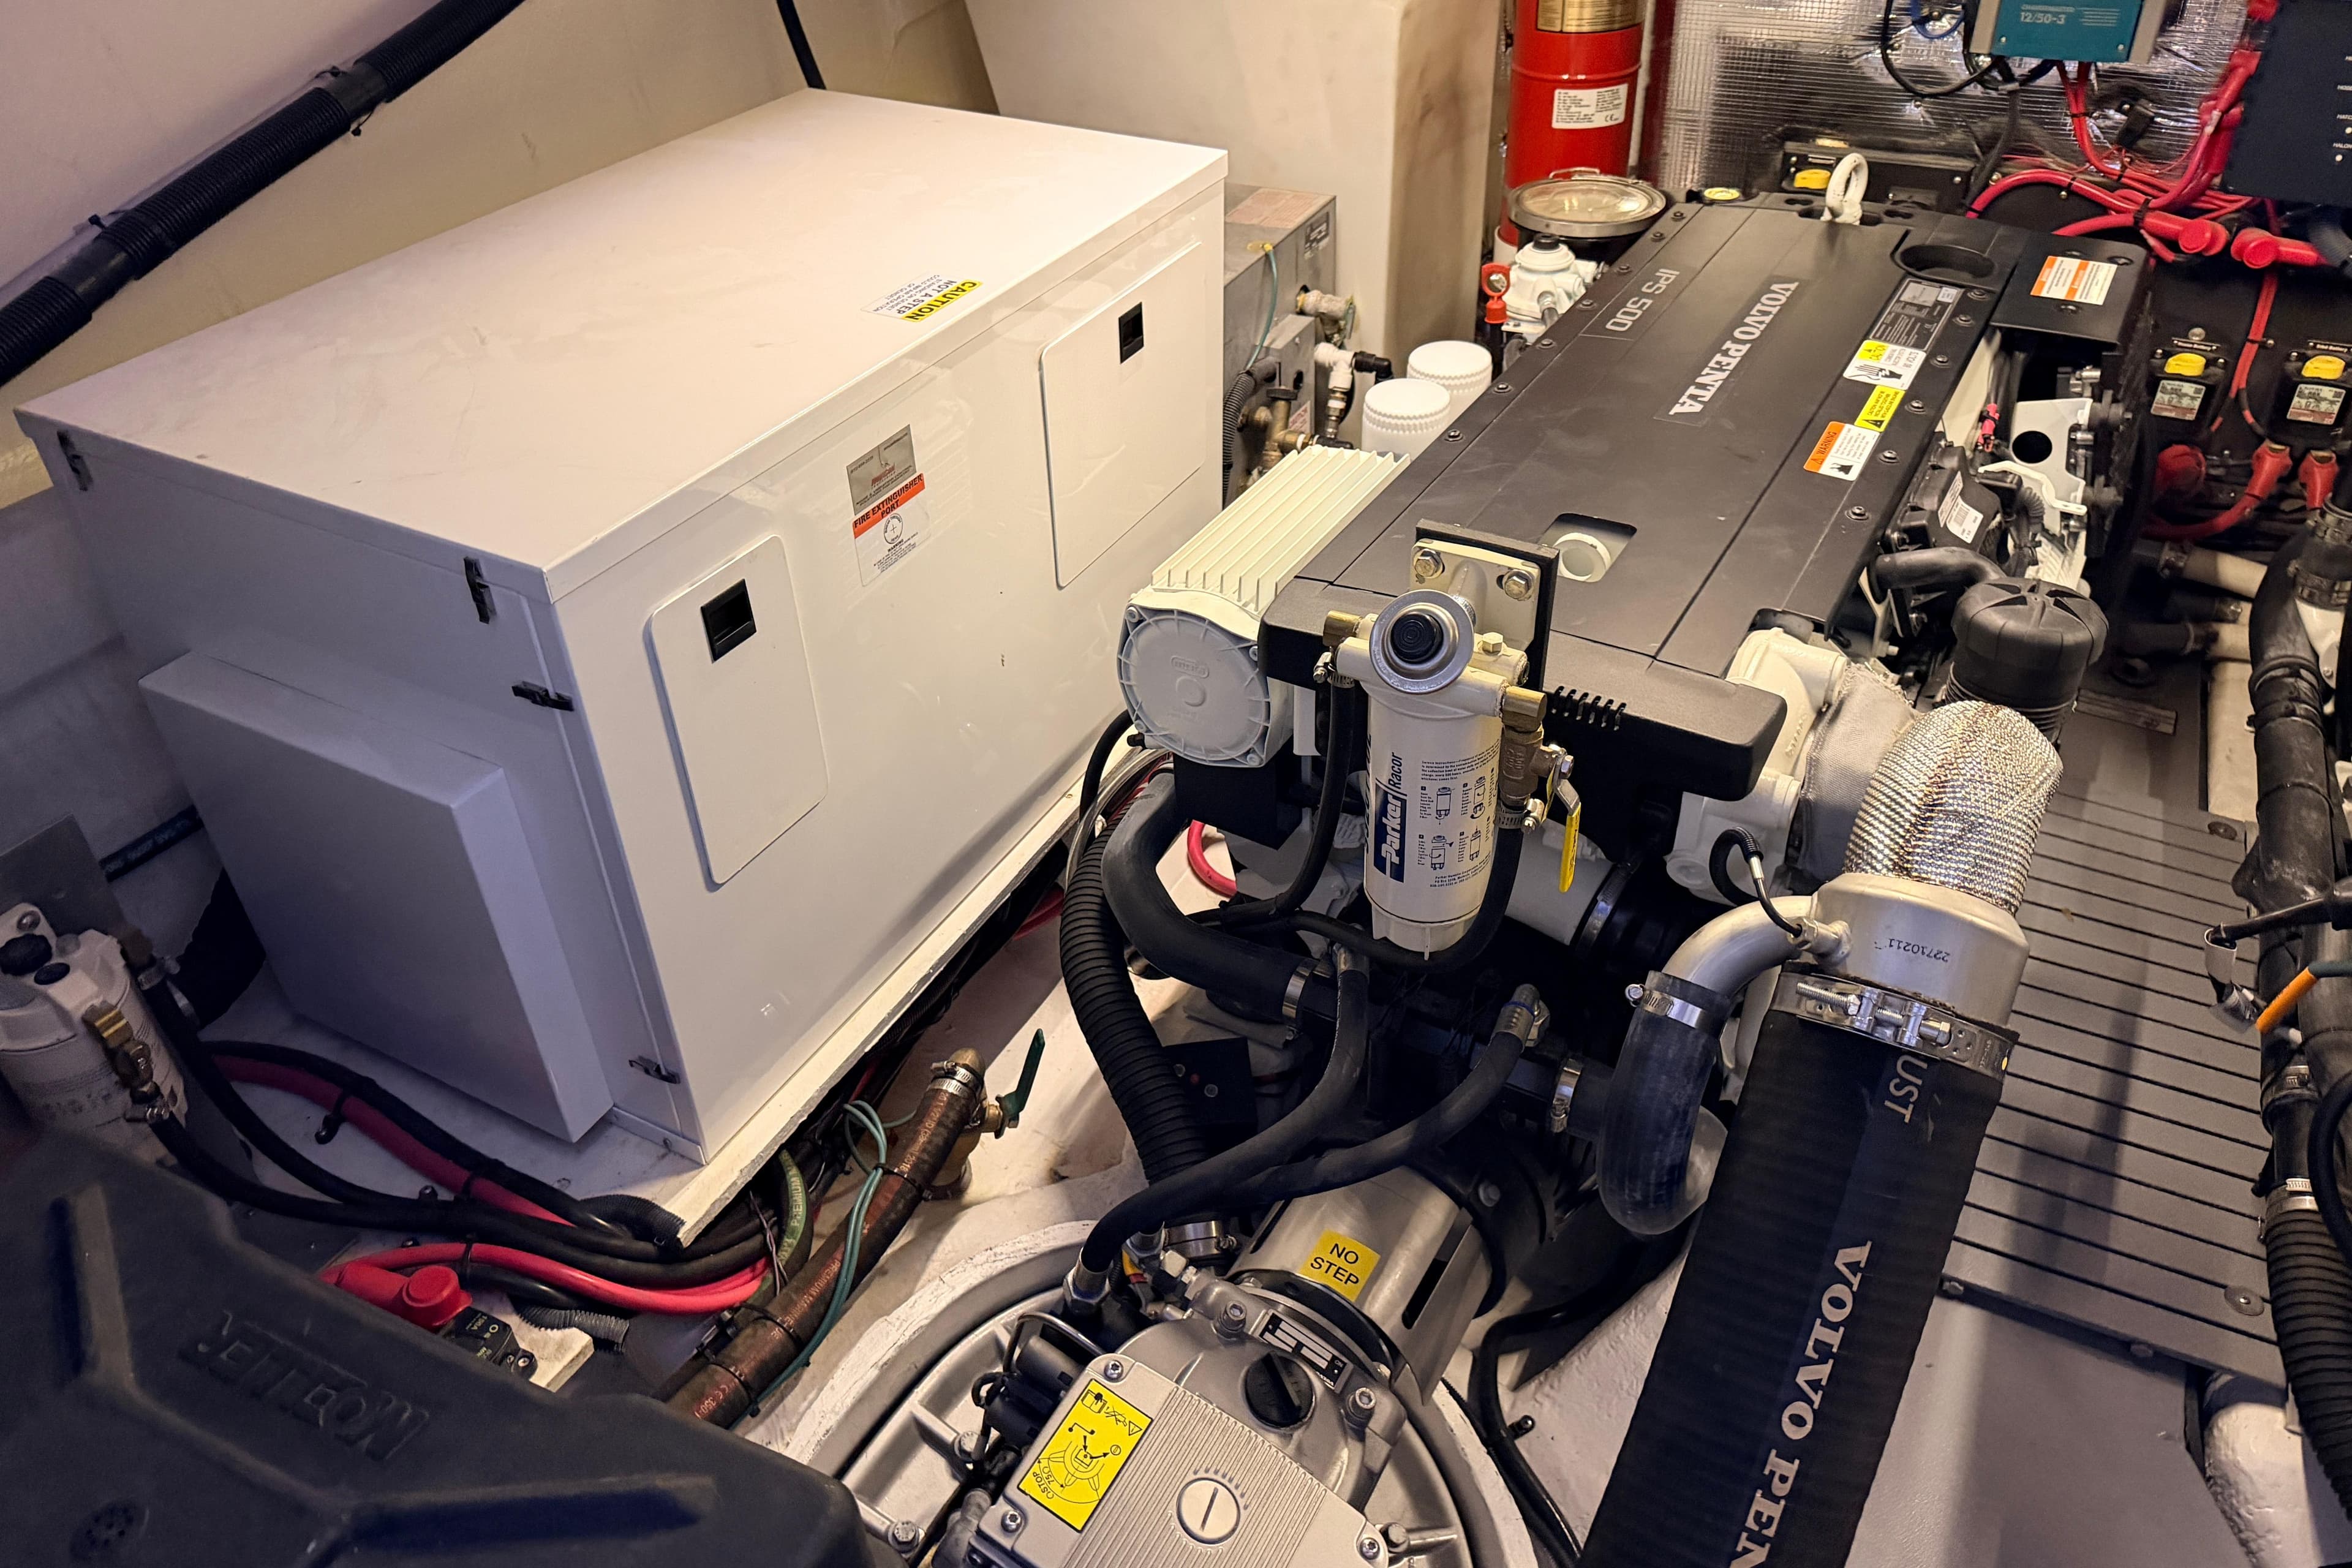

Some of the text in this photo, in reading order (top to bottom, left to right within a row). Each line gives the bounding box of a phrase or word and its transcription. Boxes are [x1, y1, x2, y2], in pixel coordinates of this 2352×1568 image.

[2021, 12, 2066, 24] 12/50-3
[905, 281, 978, 320] CAUTION
[932, 280, 957, 293] NOT
[1605, 268, 1680, 331] IPS 500
[896, 298, 925, 314] STEP
[1668, 281, 1800, 415] VOLVO PENTA
[1817, 429, 1836, 456] WARNING
[854, 510, 871, 529] FIRE
[872, 474, 923, 515] EXTINGUISHER
[881, 499, 900, 518] PORT
[888, 538, 904, 552] WARNING
[1381, 752, 1403, 864] Parker Racor
[1888, 938, 1951, 963] 22710211
[1329, 1243, 1359, 1264] NO
[809, 1257, 841, 1296] PREMIUM
[1310, 1256, 1359, 1286] STEP
[1781, 1240, 1872, 1440] VOLVO
